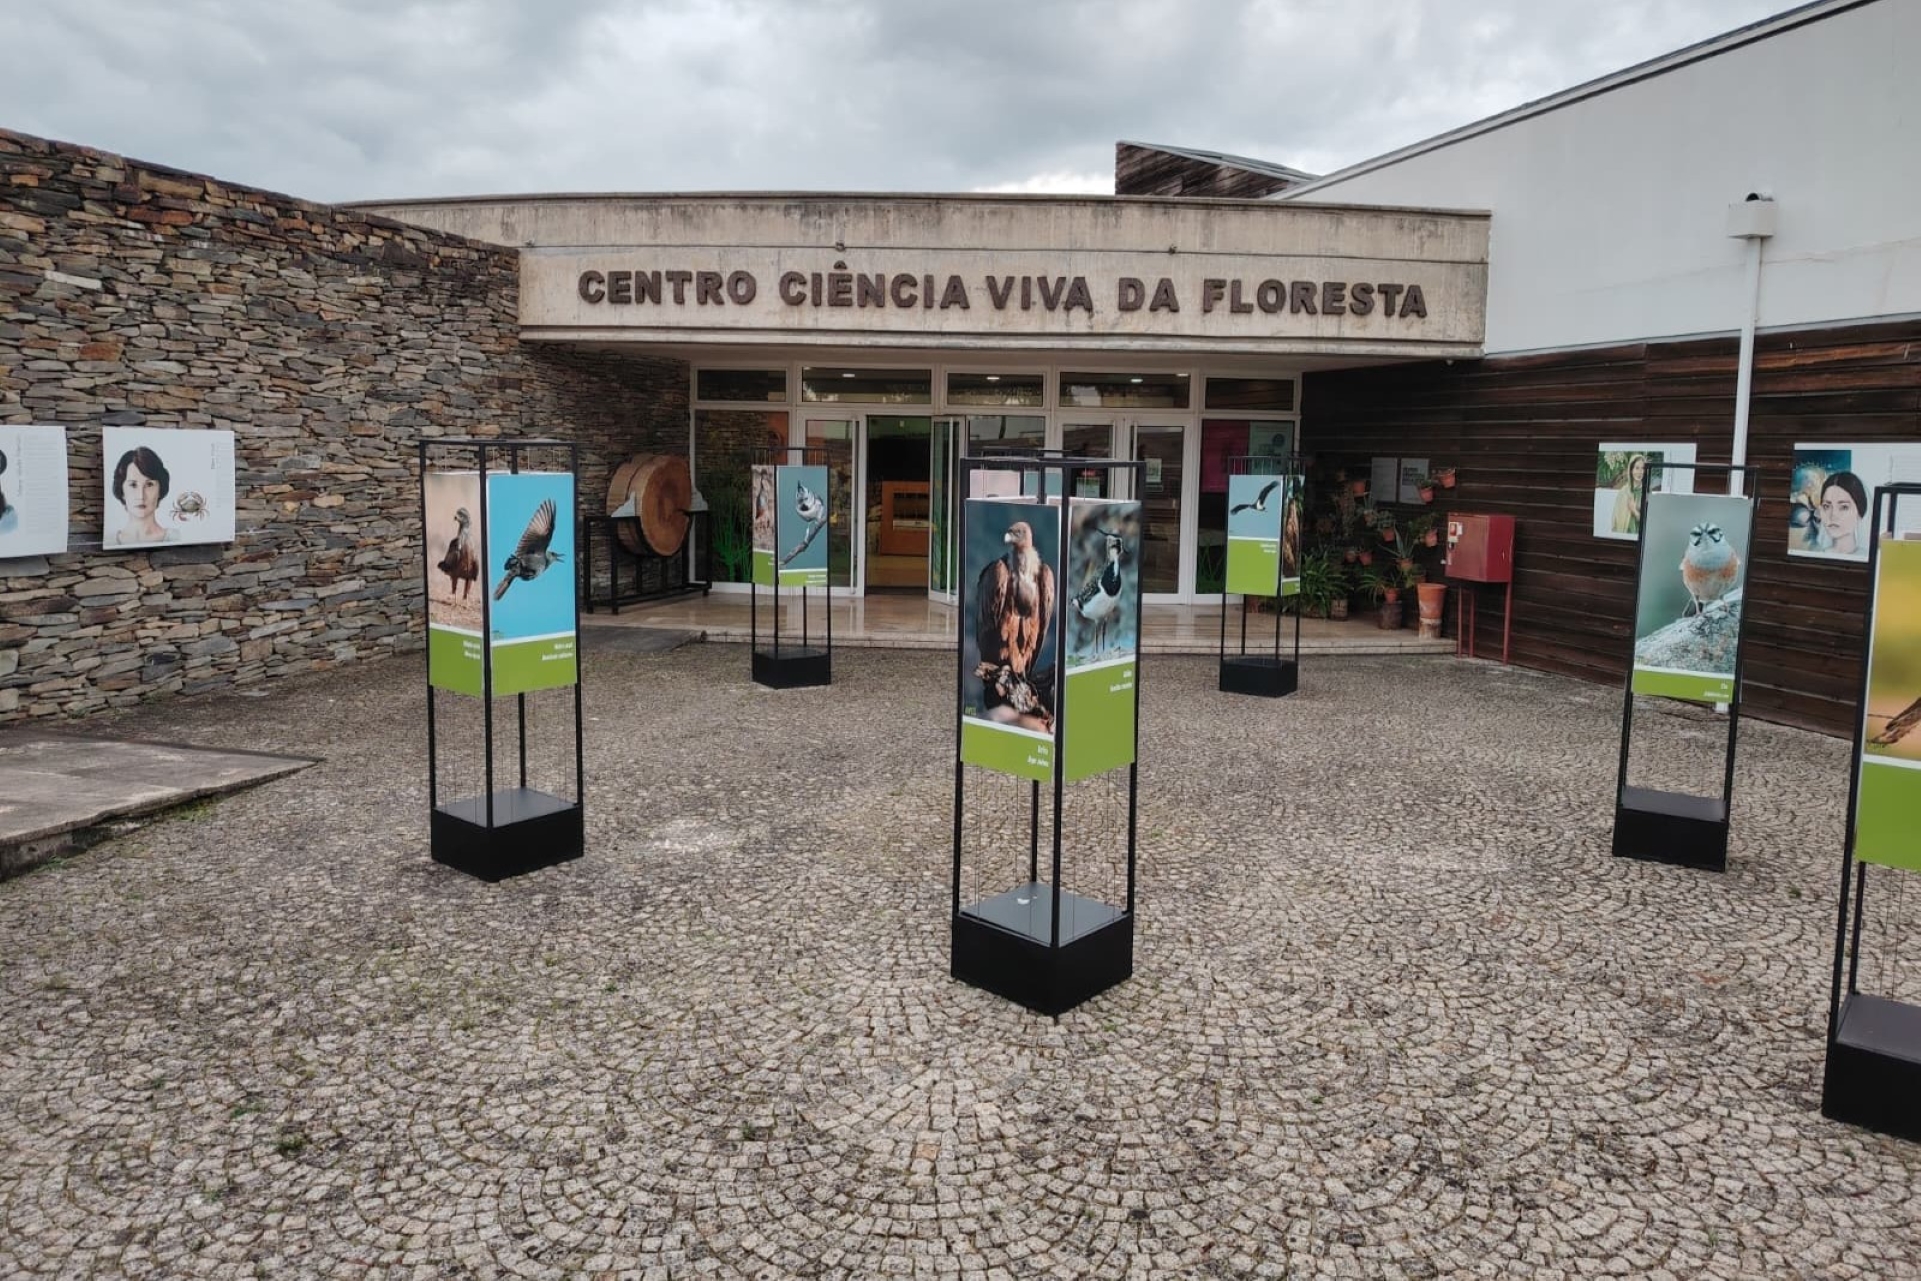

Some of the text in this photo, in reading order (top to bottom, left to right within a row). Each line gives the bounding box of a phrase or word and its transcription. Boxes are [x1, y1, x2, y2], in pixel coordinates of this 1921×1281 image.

[578, 259, 1428, 318] CENTRO CIÊNCIA VIVA DA FLORESTA
